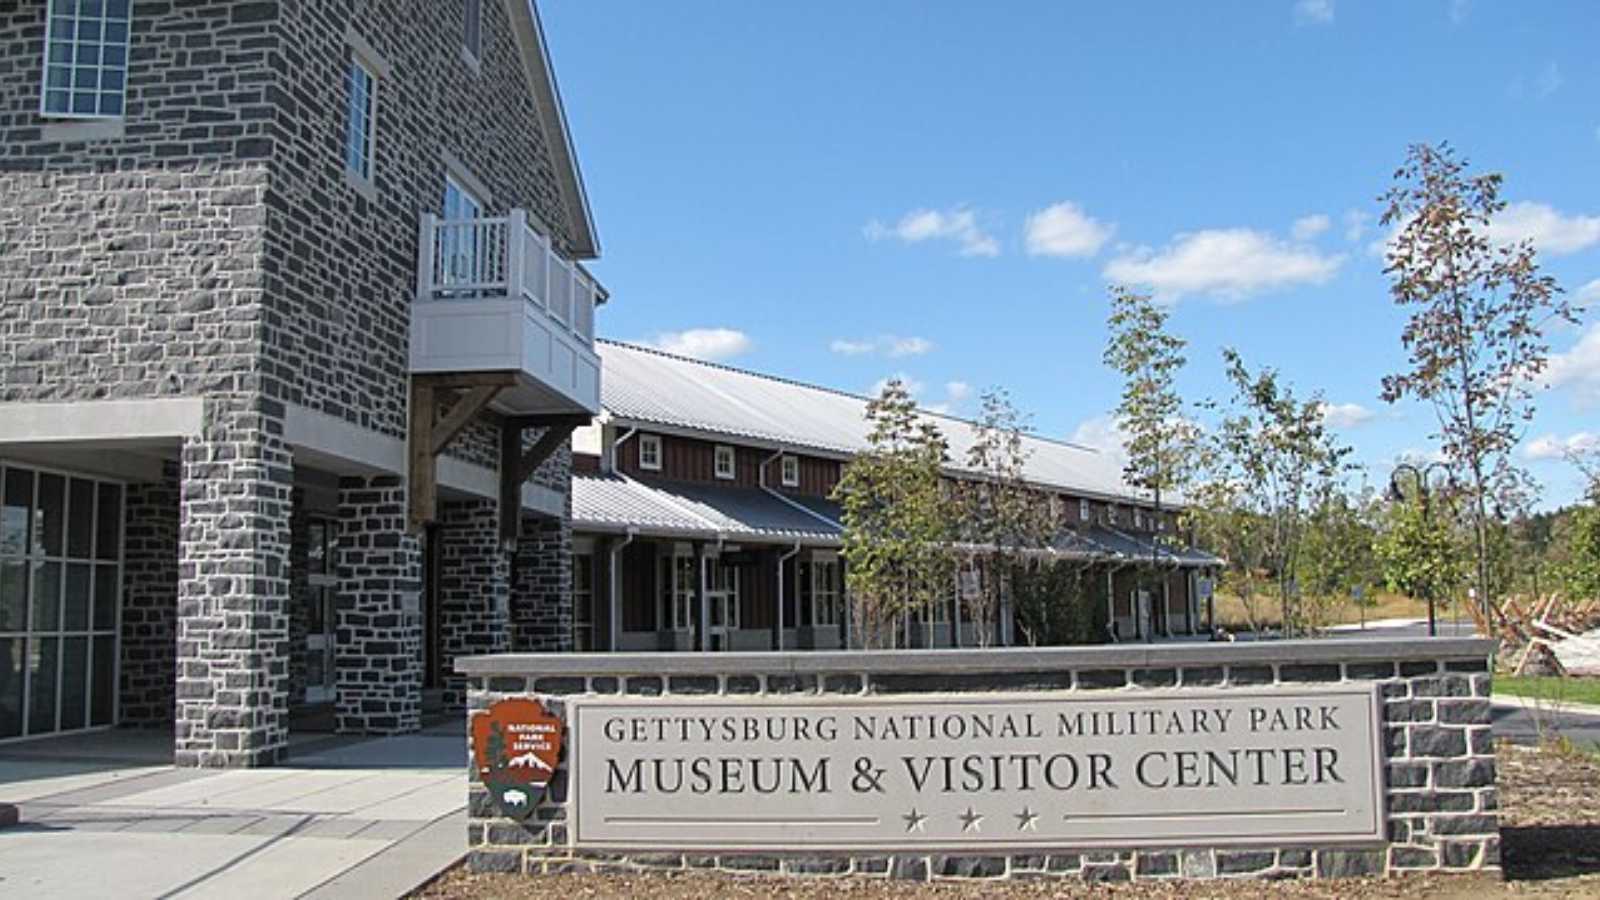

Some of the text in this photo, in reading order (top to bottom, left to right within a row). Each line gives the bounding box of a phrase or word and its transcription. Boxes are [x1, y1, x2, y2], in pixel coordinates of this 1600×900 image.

[507, 724, 556, 733] NATIONAL
[604, 706, 1341, 743] GETTYSBURG NATIONAL MILITARY PARK
[518, 733, 544, 741] PARK
[512, 742, 552, 751] SERVICE
[604, 747, 1345, 795] MUSEUM & VISITOR CENTER
